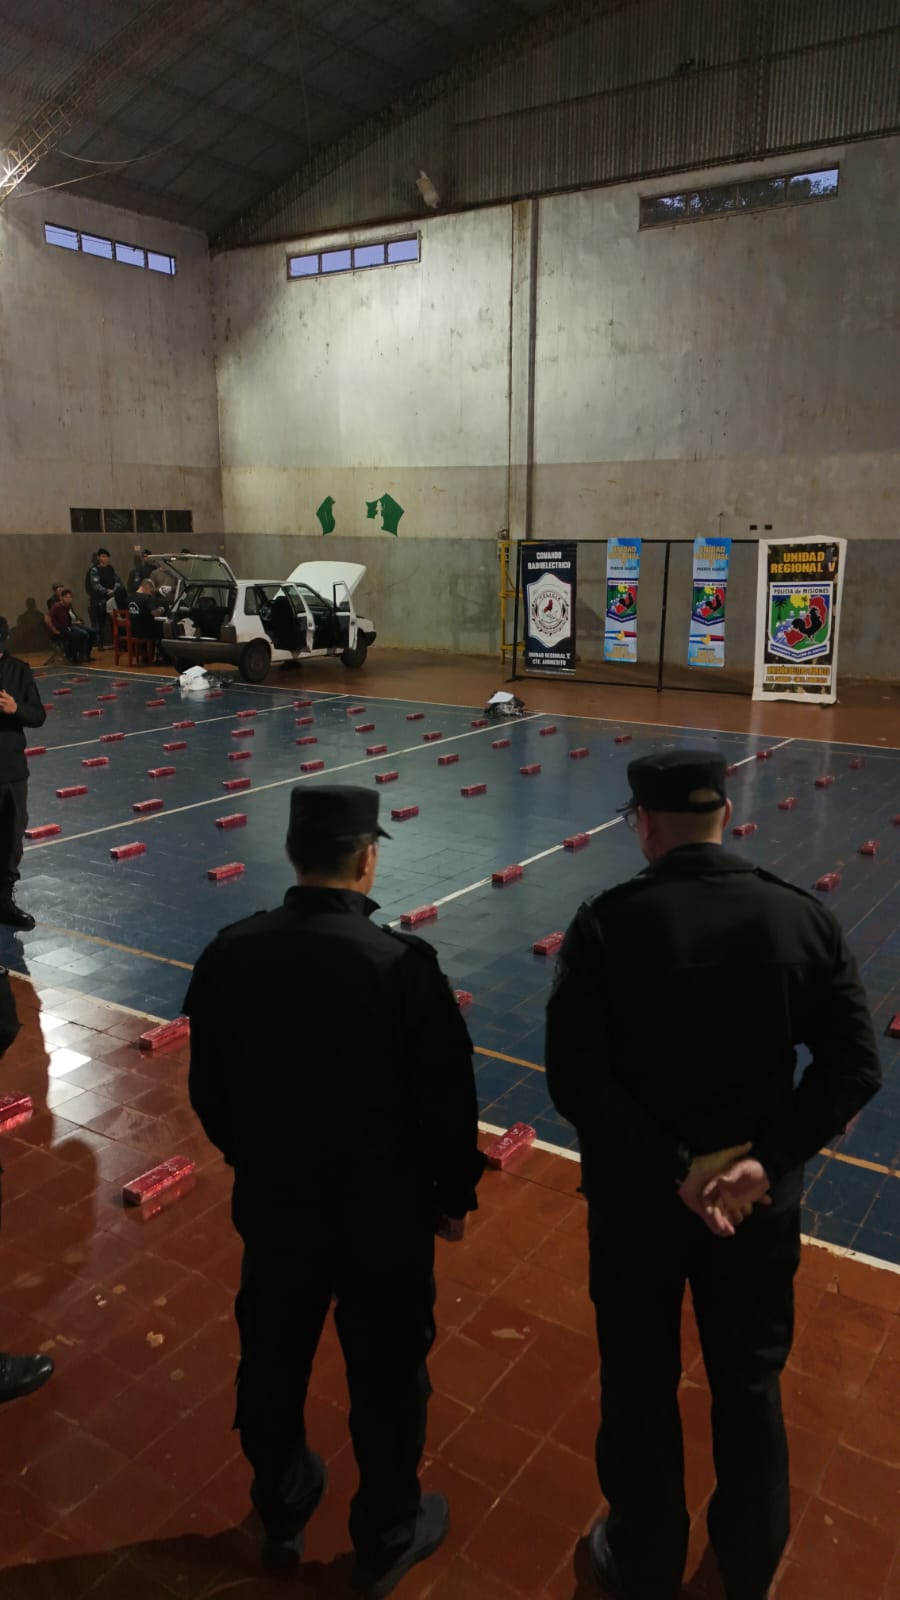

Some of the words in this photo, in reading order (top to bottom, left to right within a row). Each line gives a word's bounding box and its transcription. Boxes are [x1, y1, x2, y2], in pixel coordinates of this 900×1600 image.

[536, 551, 562, 560] COMANDO
[783, 551, 825, 562] UNIDAD
[770, 562, 824, 573] REGIONAL
[828, 562, 836, 572] V
